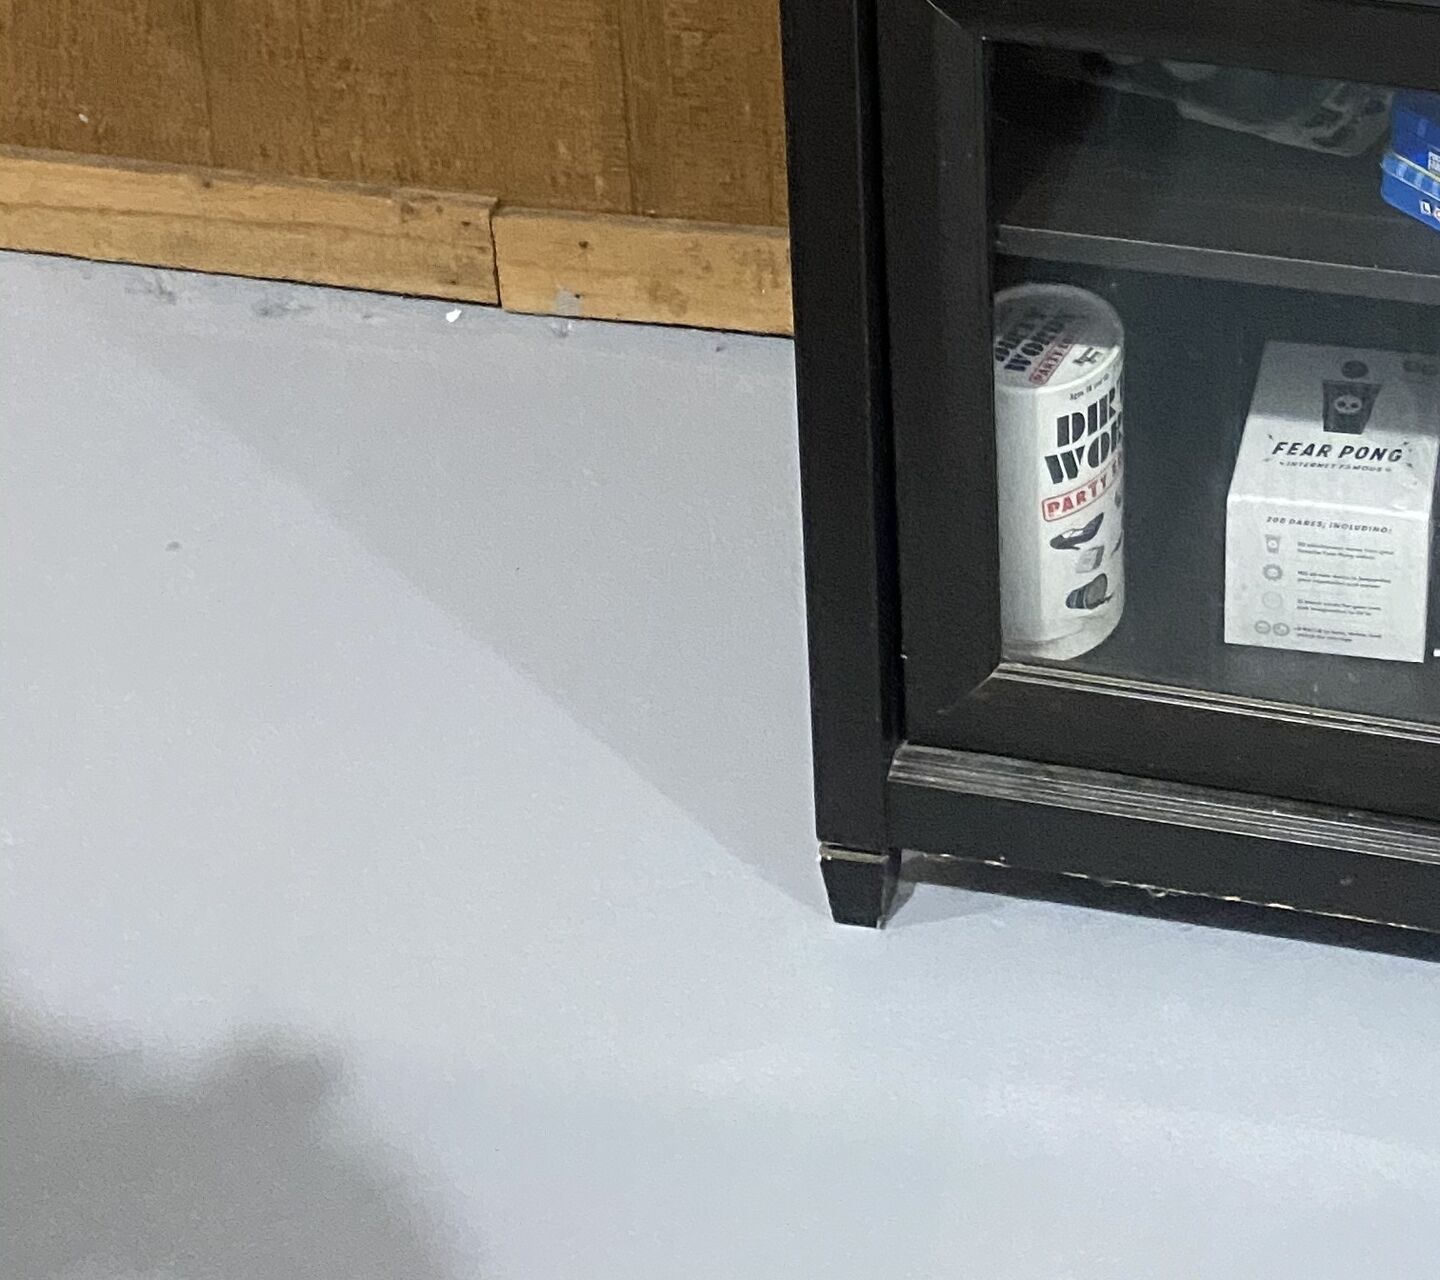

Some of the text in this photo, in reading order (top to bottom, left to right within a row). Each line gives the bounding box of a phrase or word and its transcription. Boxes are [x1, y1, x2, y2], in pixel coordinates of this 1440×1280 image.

[1272, 441, 1403, 462] FEAR PONG
[1338, 464, 1383, 472] FAMOUS
[1047, 472, 1109, 518] PARTY
